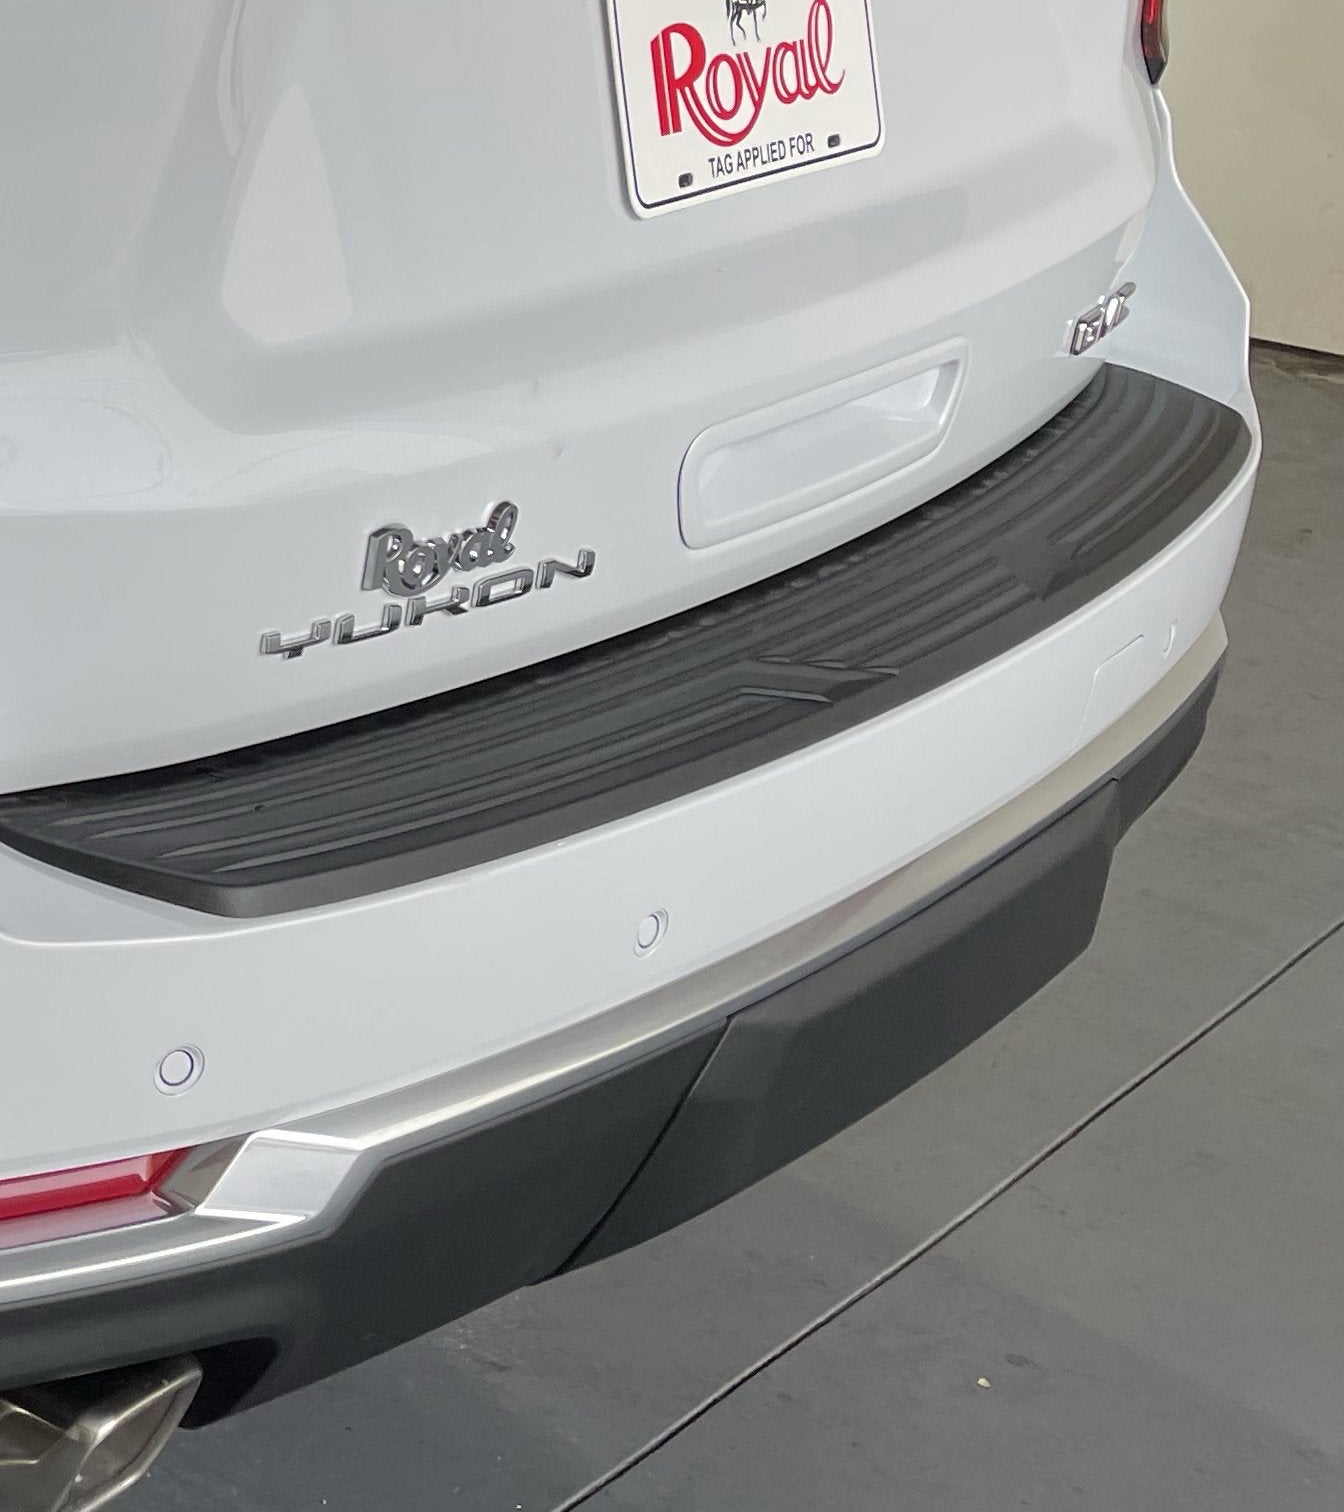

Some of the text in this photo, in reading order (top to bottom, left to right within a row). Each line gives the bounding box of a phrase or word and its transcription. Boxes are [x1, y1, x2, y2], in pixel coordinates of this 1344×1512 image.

[708, 133, 815, 178] TAG APPLIED FOR
[361, 500, 519, 597] Royal
[259, 549, 596, 660] YUKON
